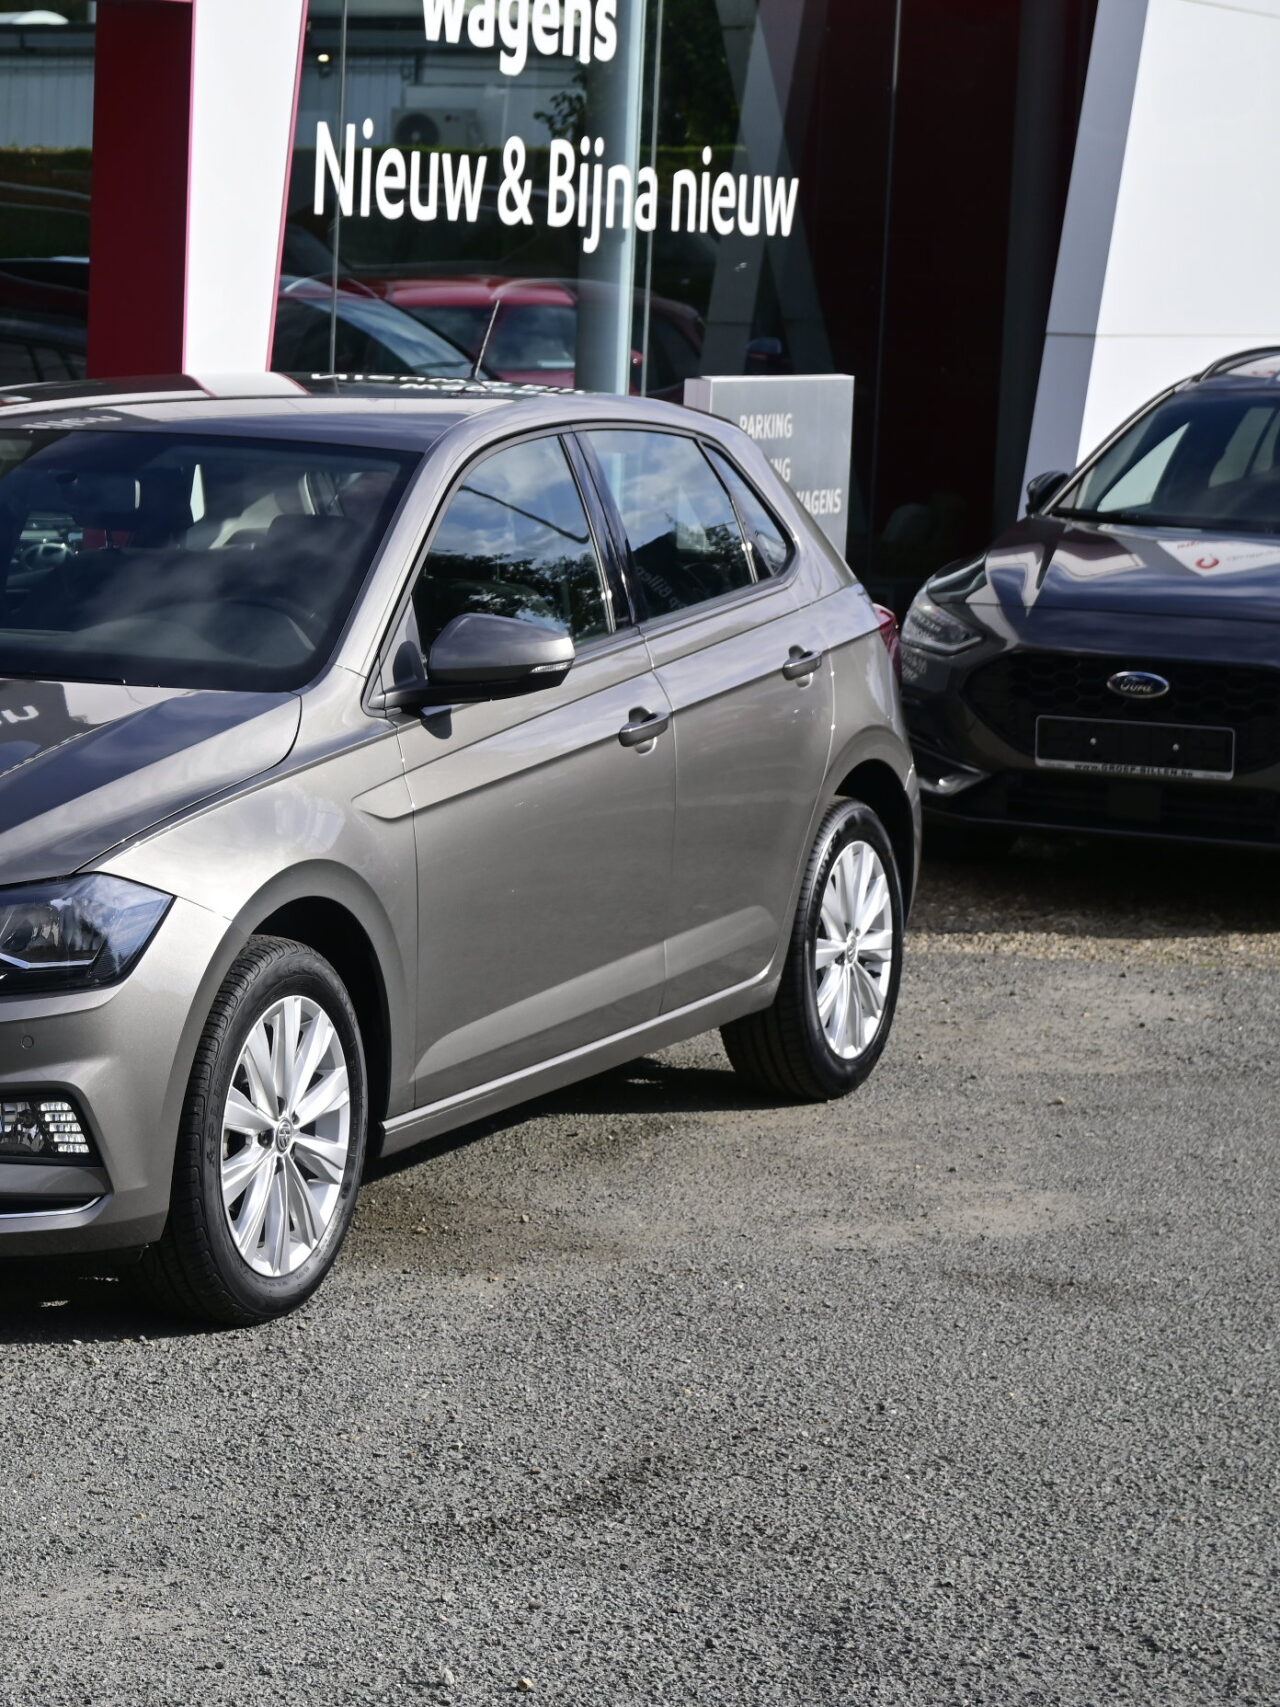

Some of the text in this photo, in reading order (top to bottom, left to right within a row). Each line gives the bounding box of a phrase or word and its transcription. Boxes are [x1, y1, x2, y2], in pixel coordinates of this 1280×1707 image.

[423, 0, 618, 76] wagens
[314, 118, 800, 254] Nieuw & Bijna nieuw
[739, 412, 793, 440] PARKING
